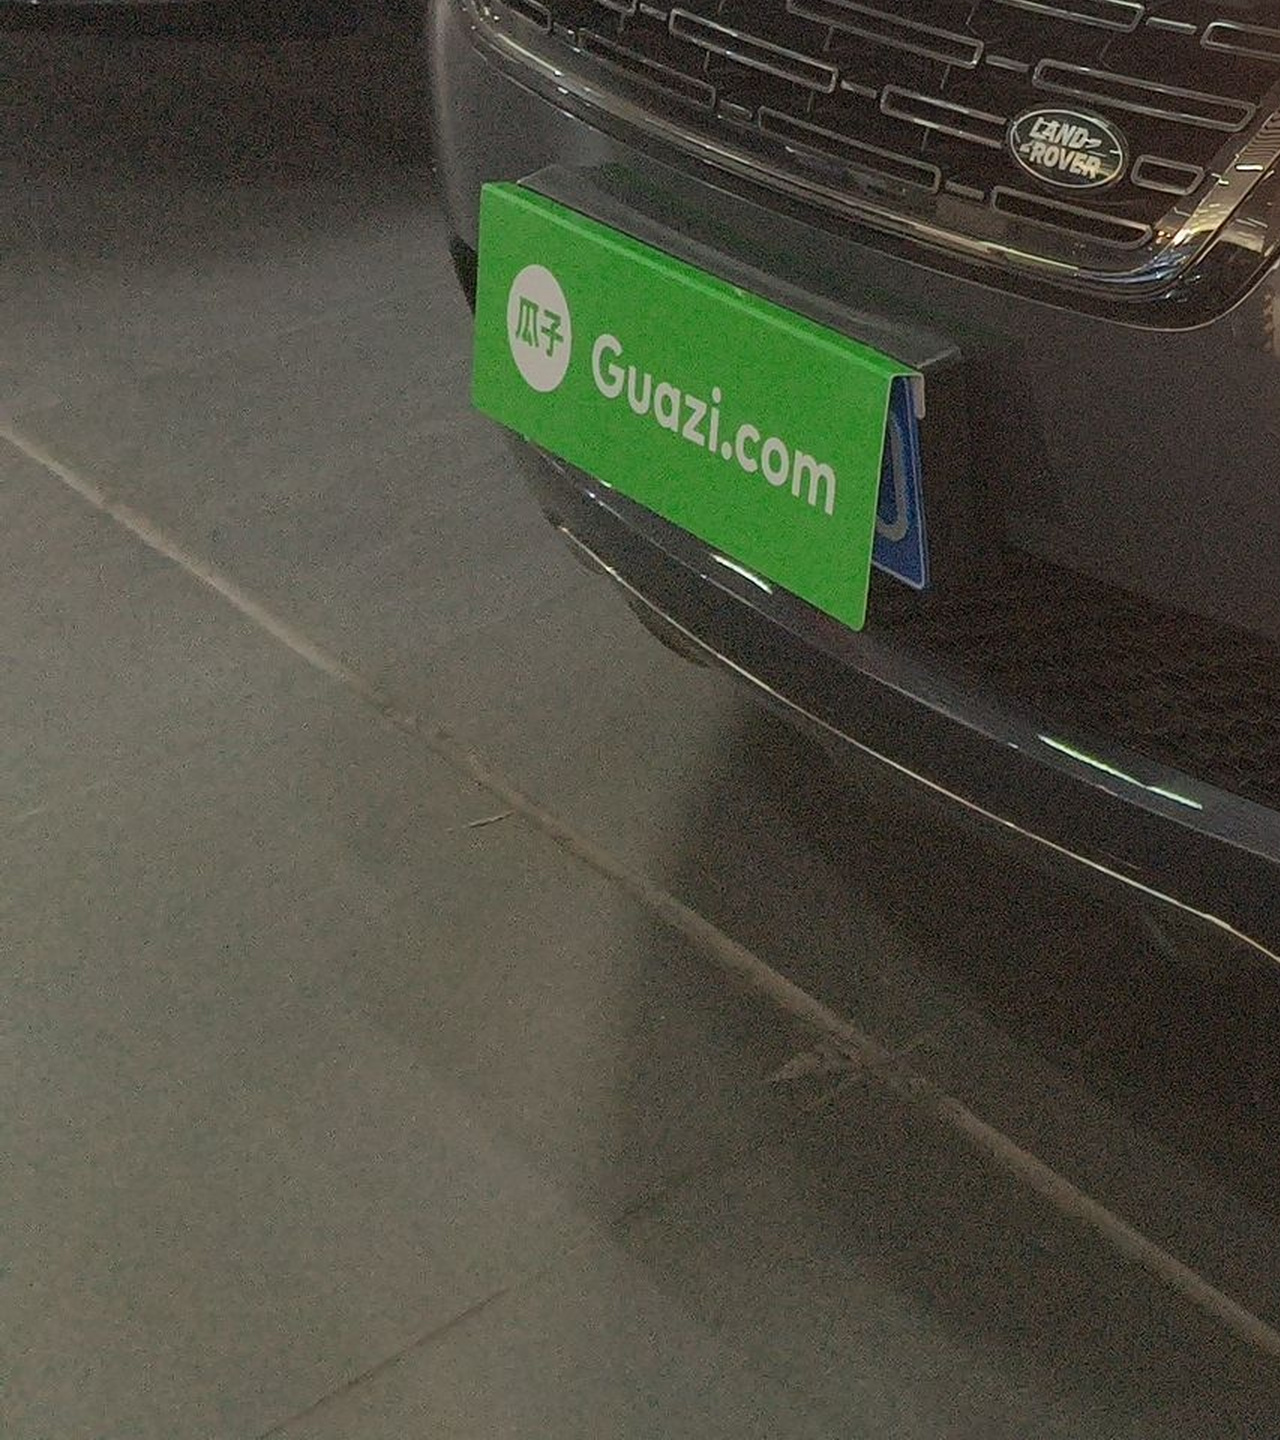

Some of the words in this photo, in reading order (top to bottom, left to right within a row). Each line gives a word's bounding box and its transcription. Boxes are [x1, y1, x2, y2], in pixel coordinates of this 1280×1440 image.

[1028, 116, 1090, 150] LAND
[1028, 140, 1102, 180] ROVER
[515, 296, 564, 358] 瓜子
[591, 333, 837, 517] Guazi.com
